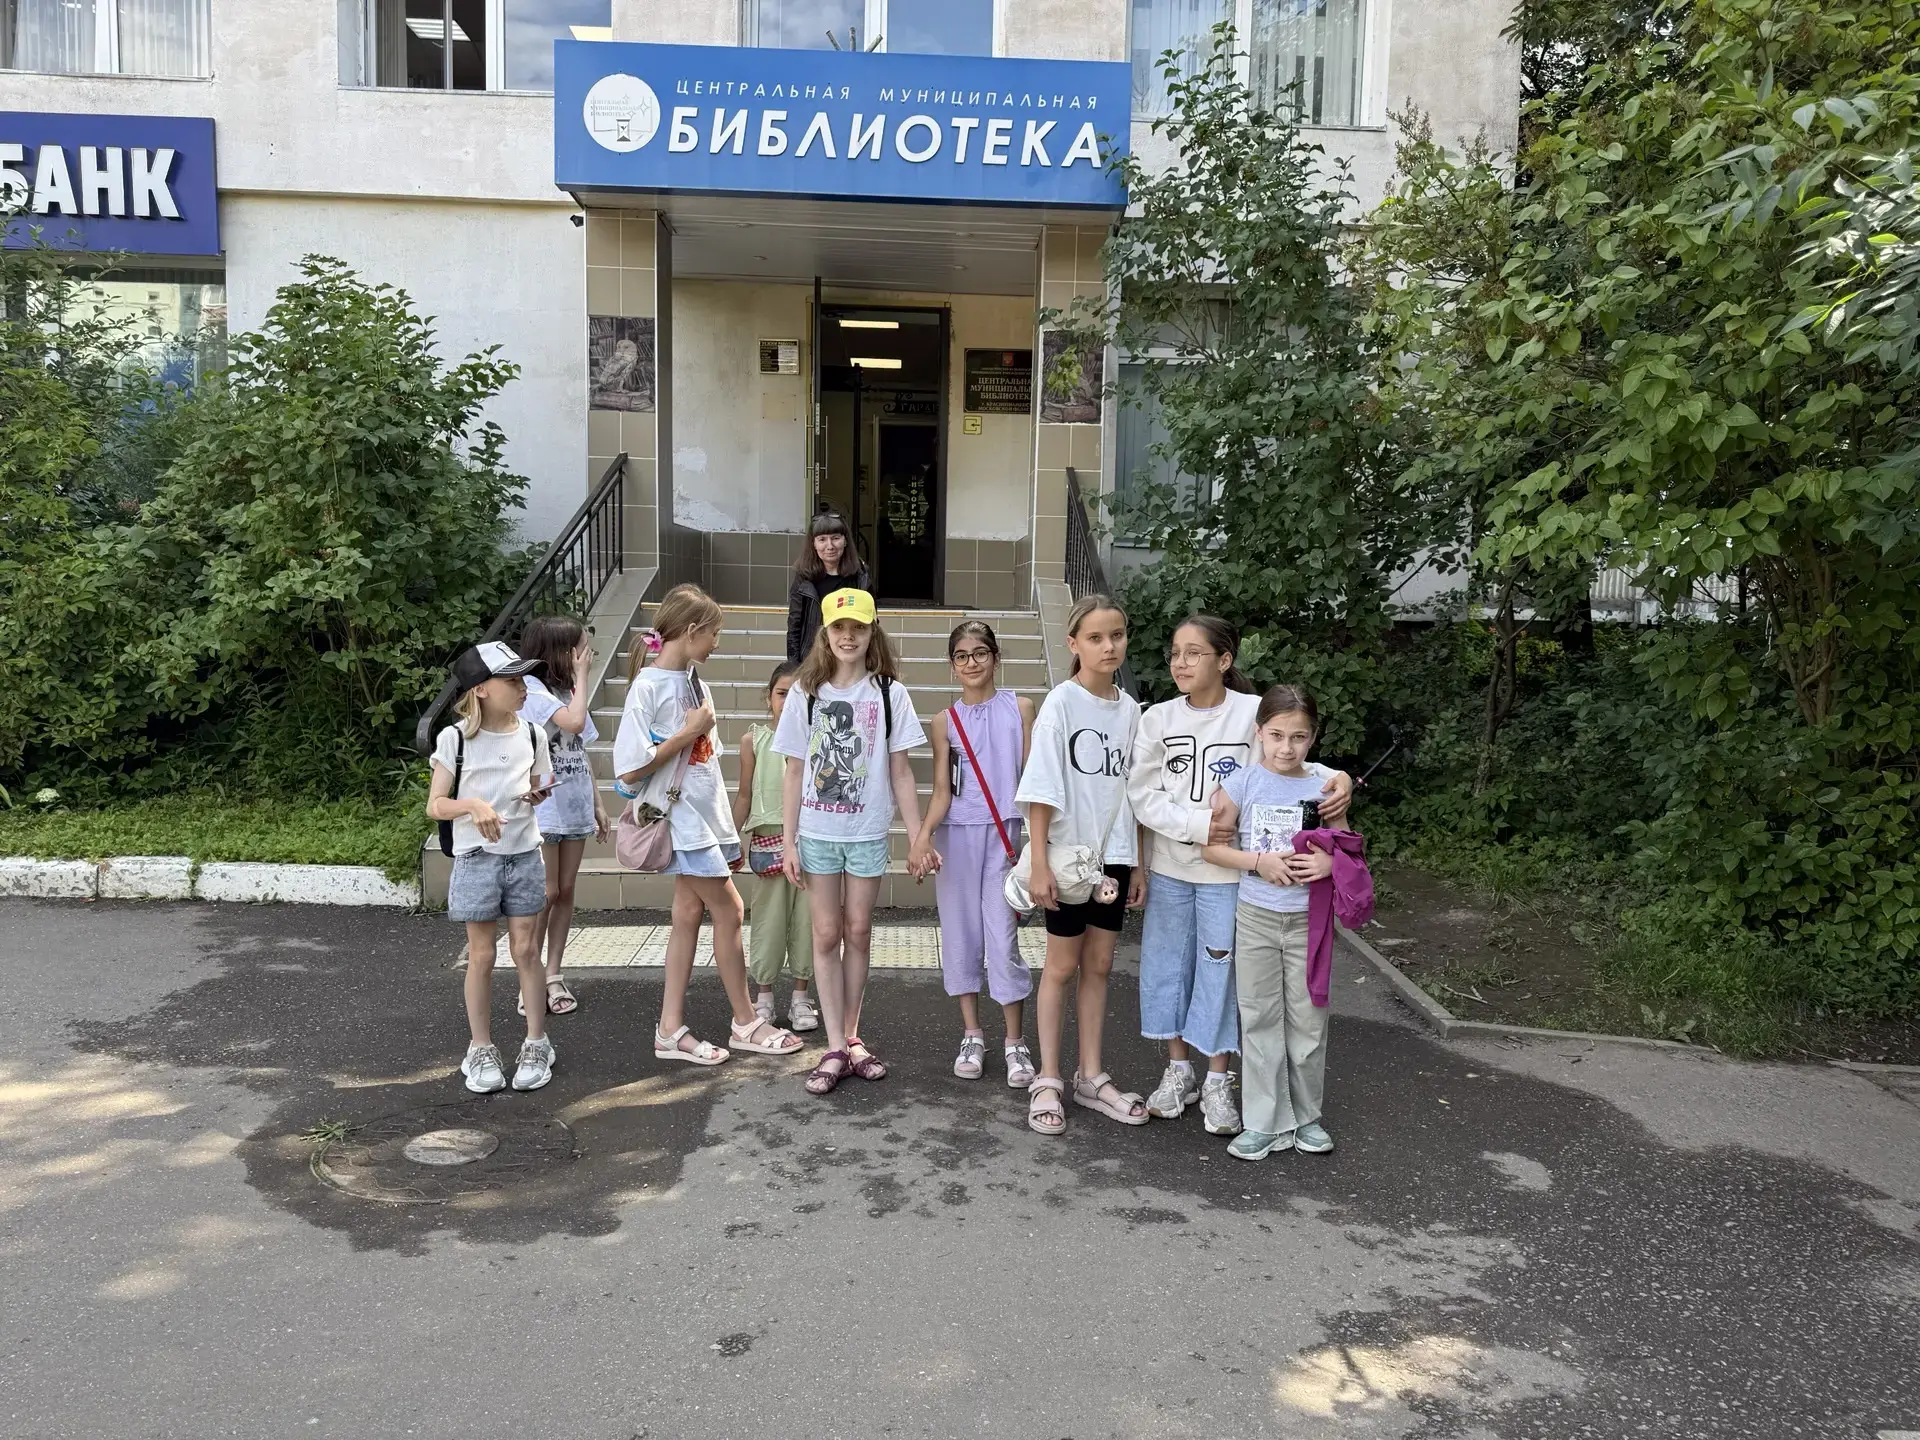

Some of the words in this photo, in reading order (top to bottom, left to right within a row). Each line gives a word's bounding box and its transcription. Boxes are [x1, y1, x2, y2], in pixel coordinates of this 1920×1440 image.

[676, 80, 850, 100] ЦЕНТРАЛЬНАЯ
[879, 88, 1098, 109] МУНИЦИПАЛЬНАЯ
[668, 106, 1102, 168] БИБЛИОТЕКА
[0, 143, 181, 218] БАНК
[801, 797, 822, 811] LIFE
